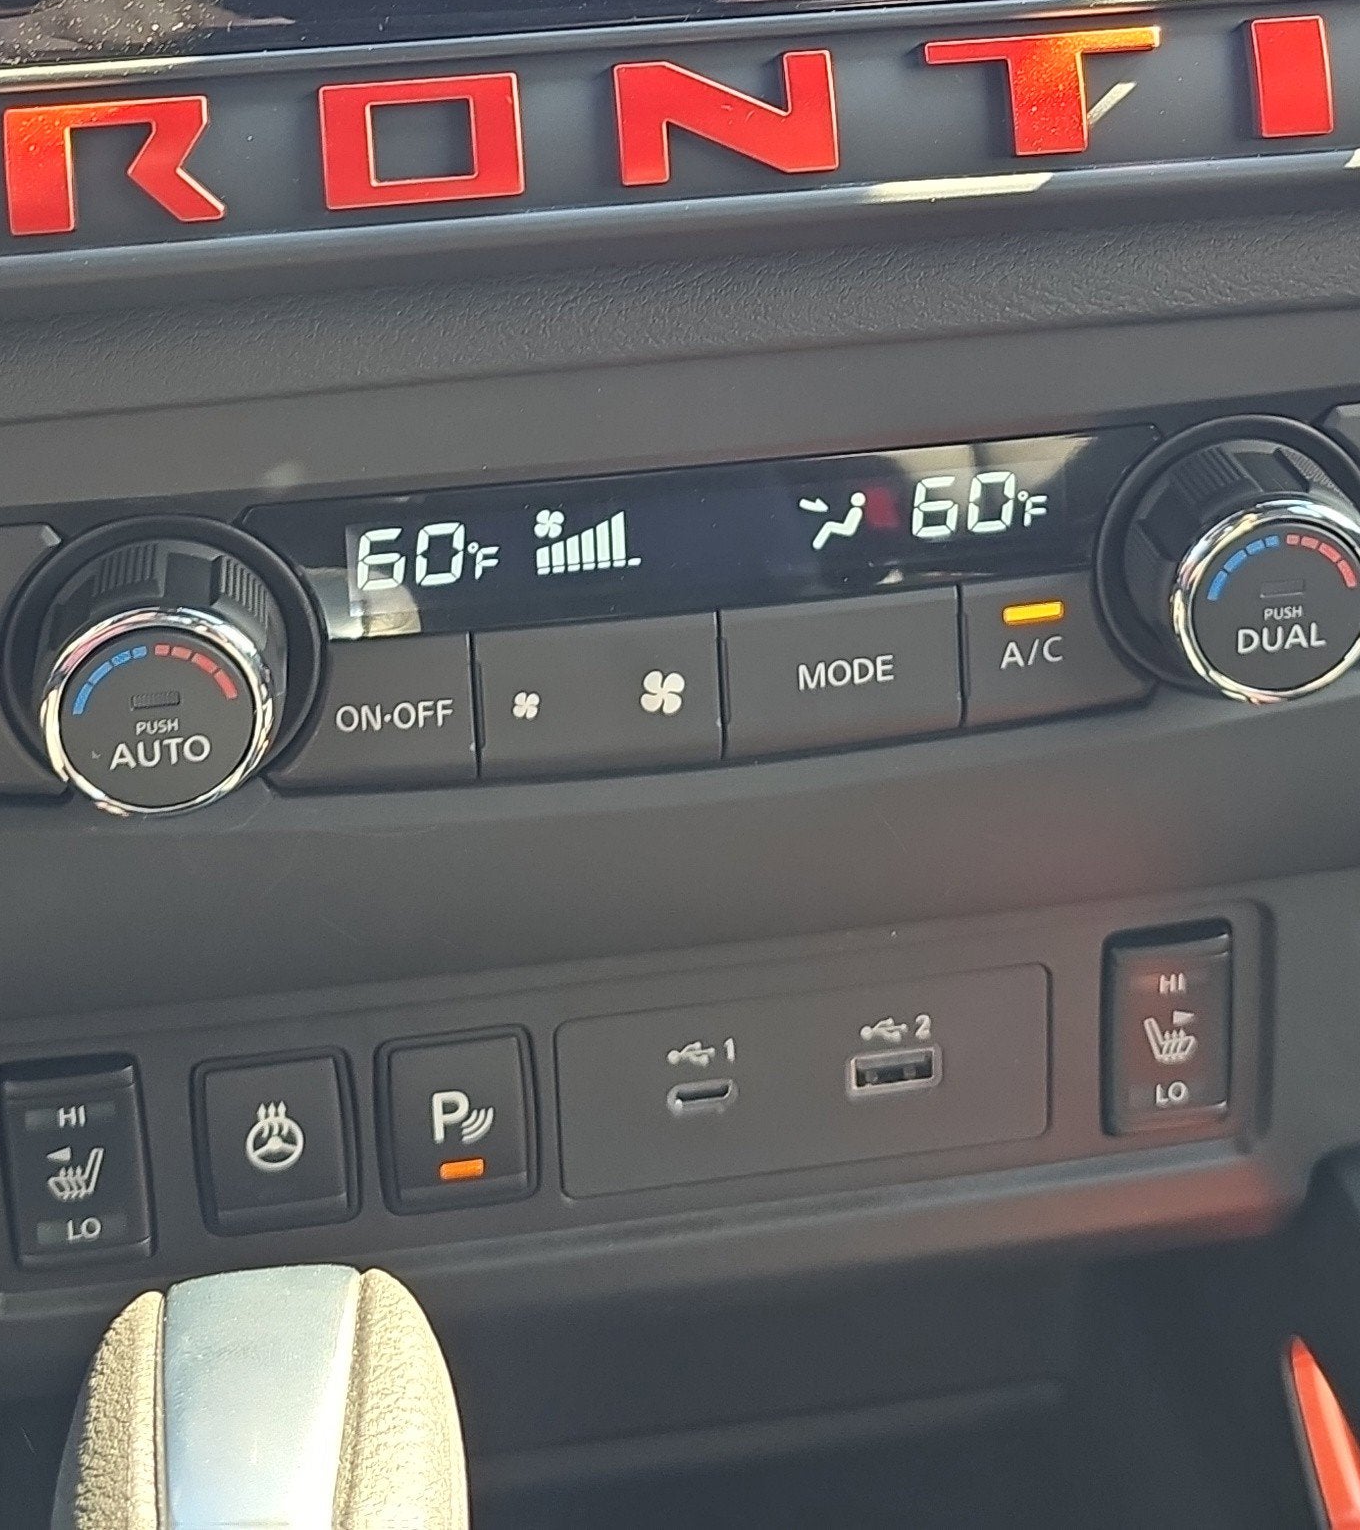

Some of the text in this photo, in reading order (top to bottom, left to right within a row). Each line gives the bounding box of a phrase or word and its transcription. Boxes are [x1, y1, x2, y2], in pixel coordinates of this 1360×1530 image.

[1264, 605, 1303, 620] PUSH
[1237, 625, 1326, 654] DUAL
[1001, 636, 1064, 670] A/C
[798, 654, 895, 691] MODE
[136, 718, 179, 735] PUSH
[109, 735, 211, 771] AUTO
[1160, 973, 1186, 995] HI
[914, 1014, 932, 1037] 2
[724, 1038, 736, 1062] 1
[1156, 1082, 1189, 1106] LO
[59, 1105, 86, 1128] HI
[430, 1089, 470, 1142] P
[67, 1218, 102, 1241] LO
